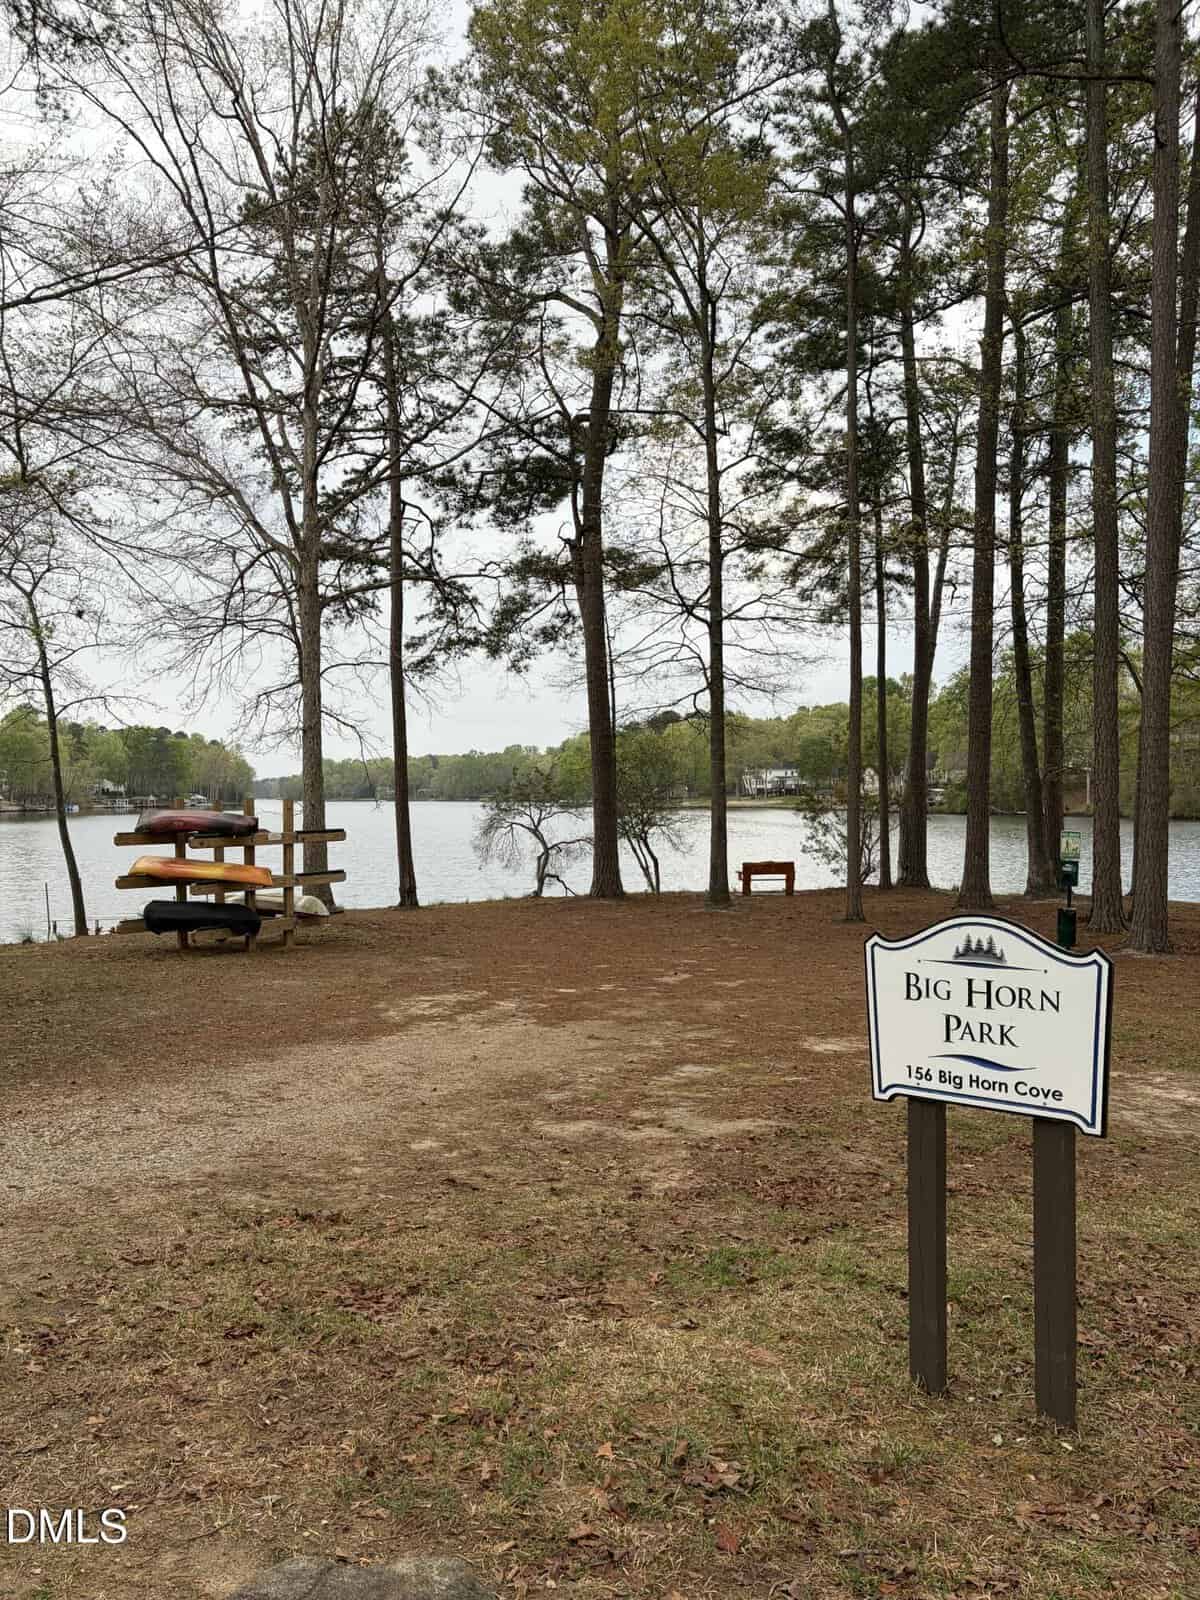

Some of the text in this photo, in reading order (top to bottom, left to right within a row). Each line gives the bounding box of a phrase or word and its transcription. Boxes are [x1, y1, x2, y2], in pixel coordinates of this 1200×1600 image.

[906, 1065, 1064, 1101] 156 Big Horn Cove
